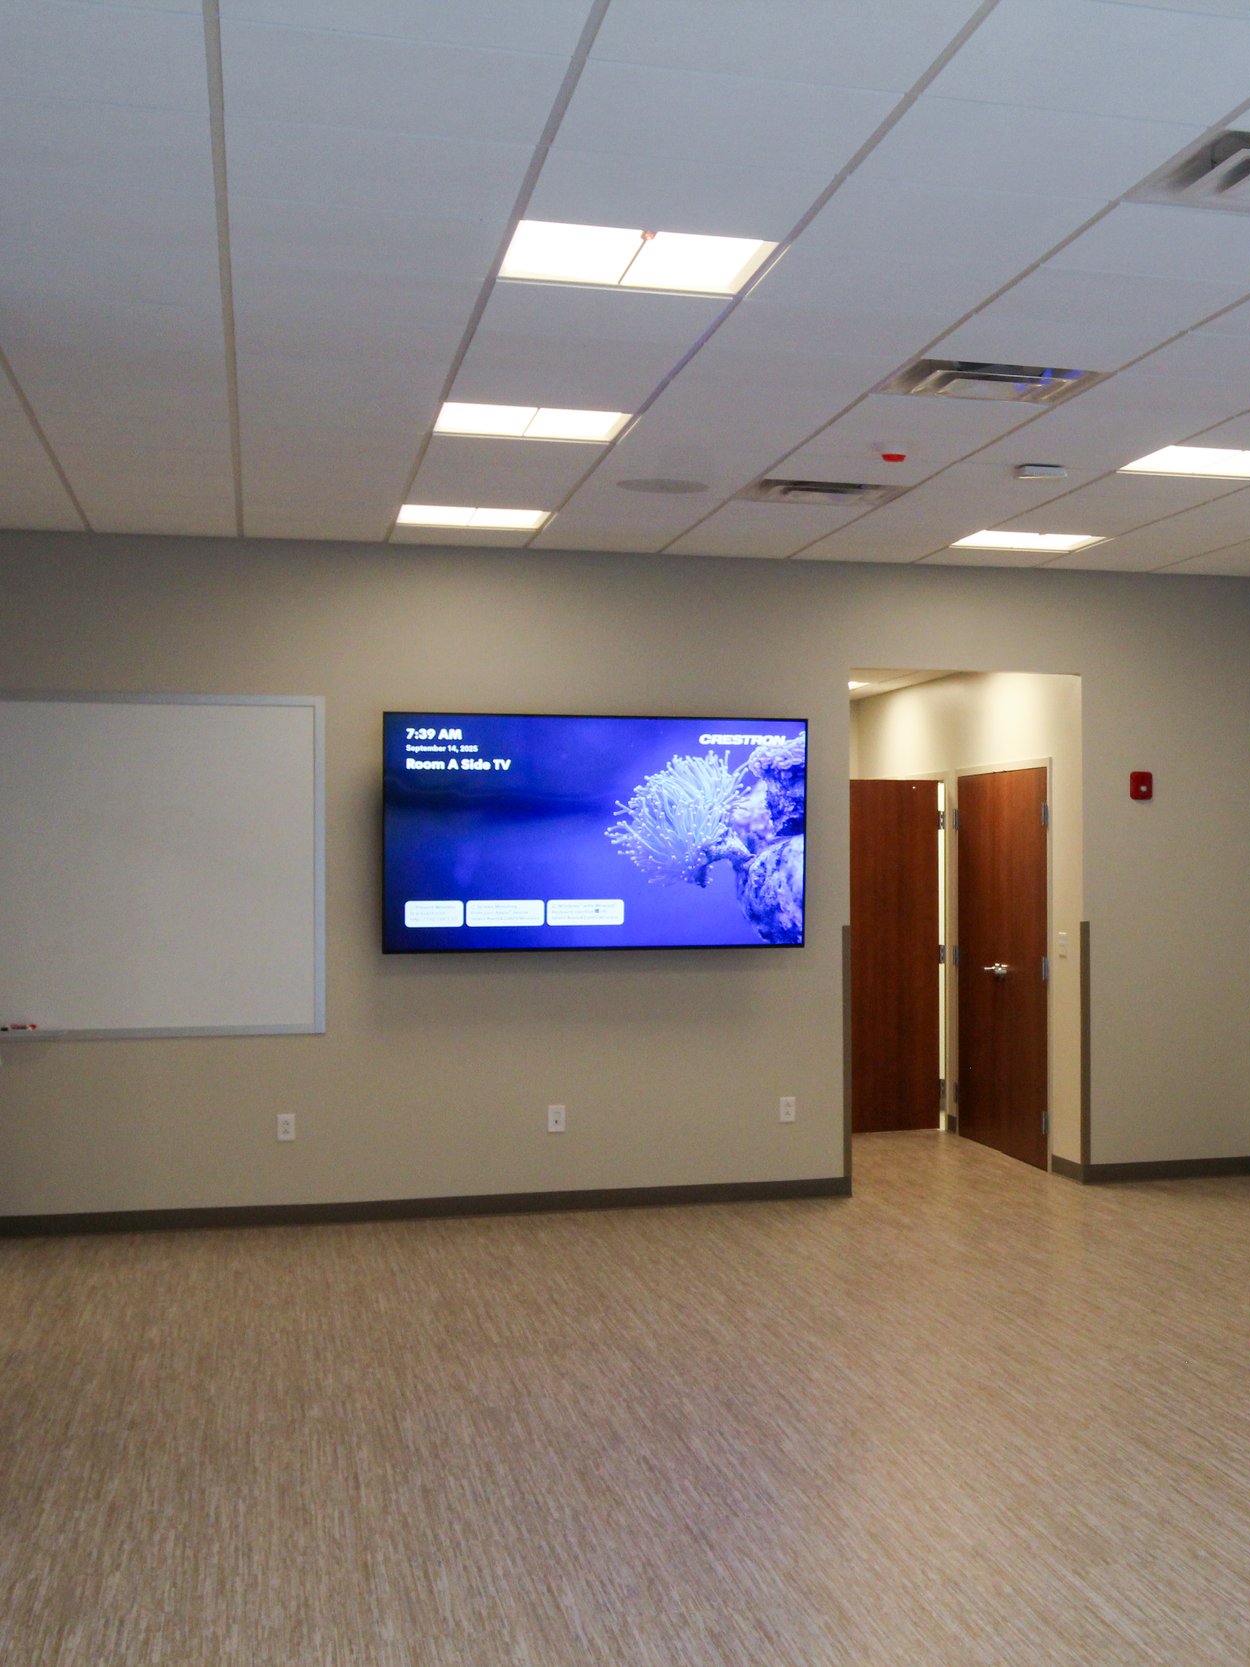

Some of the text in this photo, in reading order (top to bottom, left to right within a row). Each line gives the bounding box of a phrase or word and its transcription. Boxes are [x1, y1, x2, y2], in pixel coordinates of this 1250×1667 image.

[406, 728, 463, 740] 7:39 AM
[699, 734, 786, 745] CRESTRON
[406, 744, 446, 753] September
[447, 745, 459, 753] 14,
[406, 758, 512, 770] Room A Side TV
